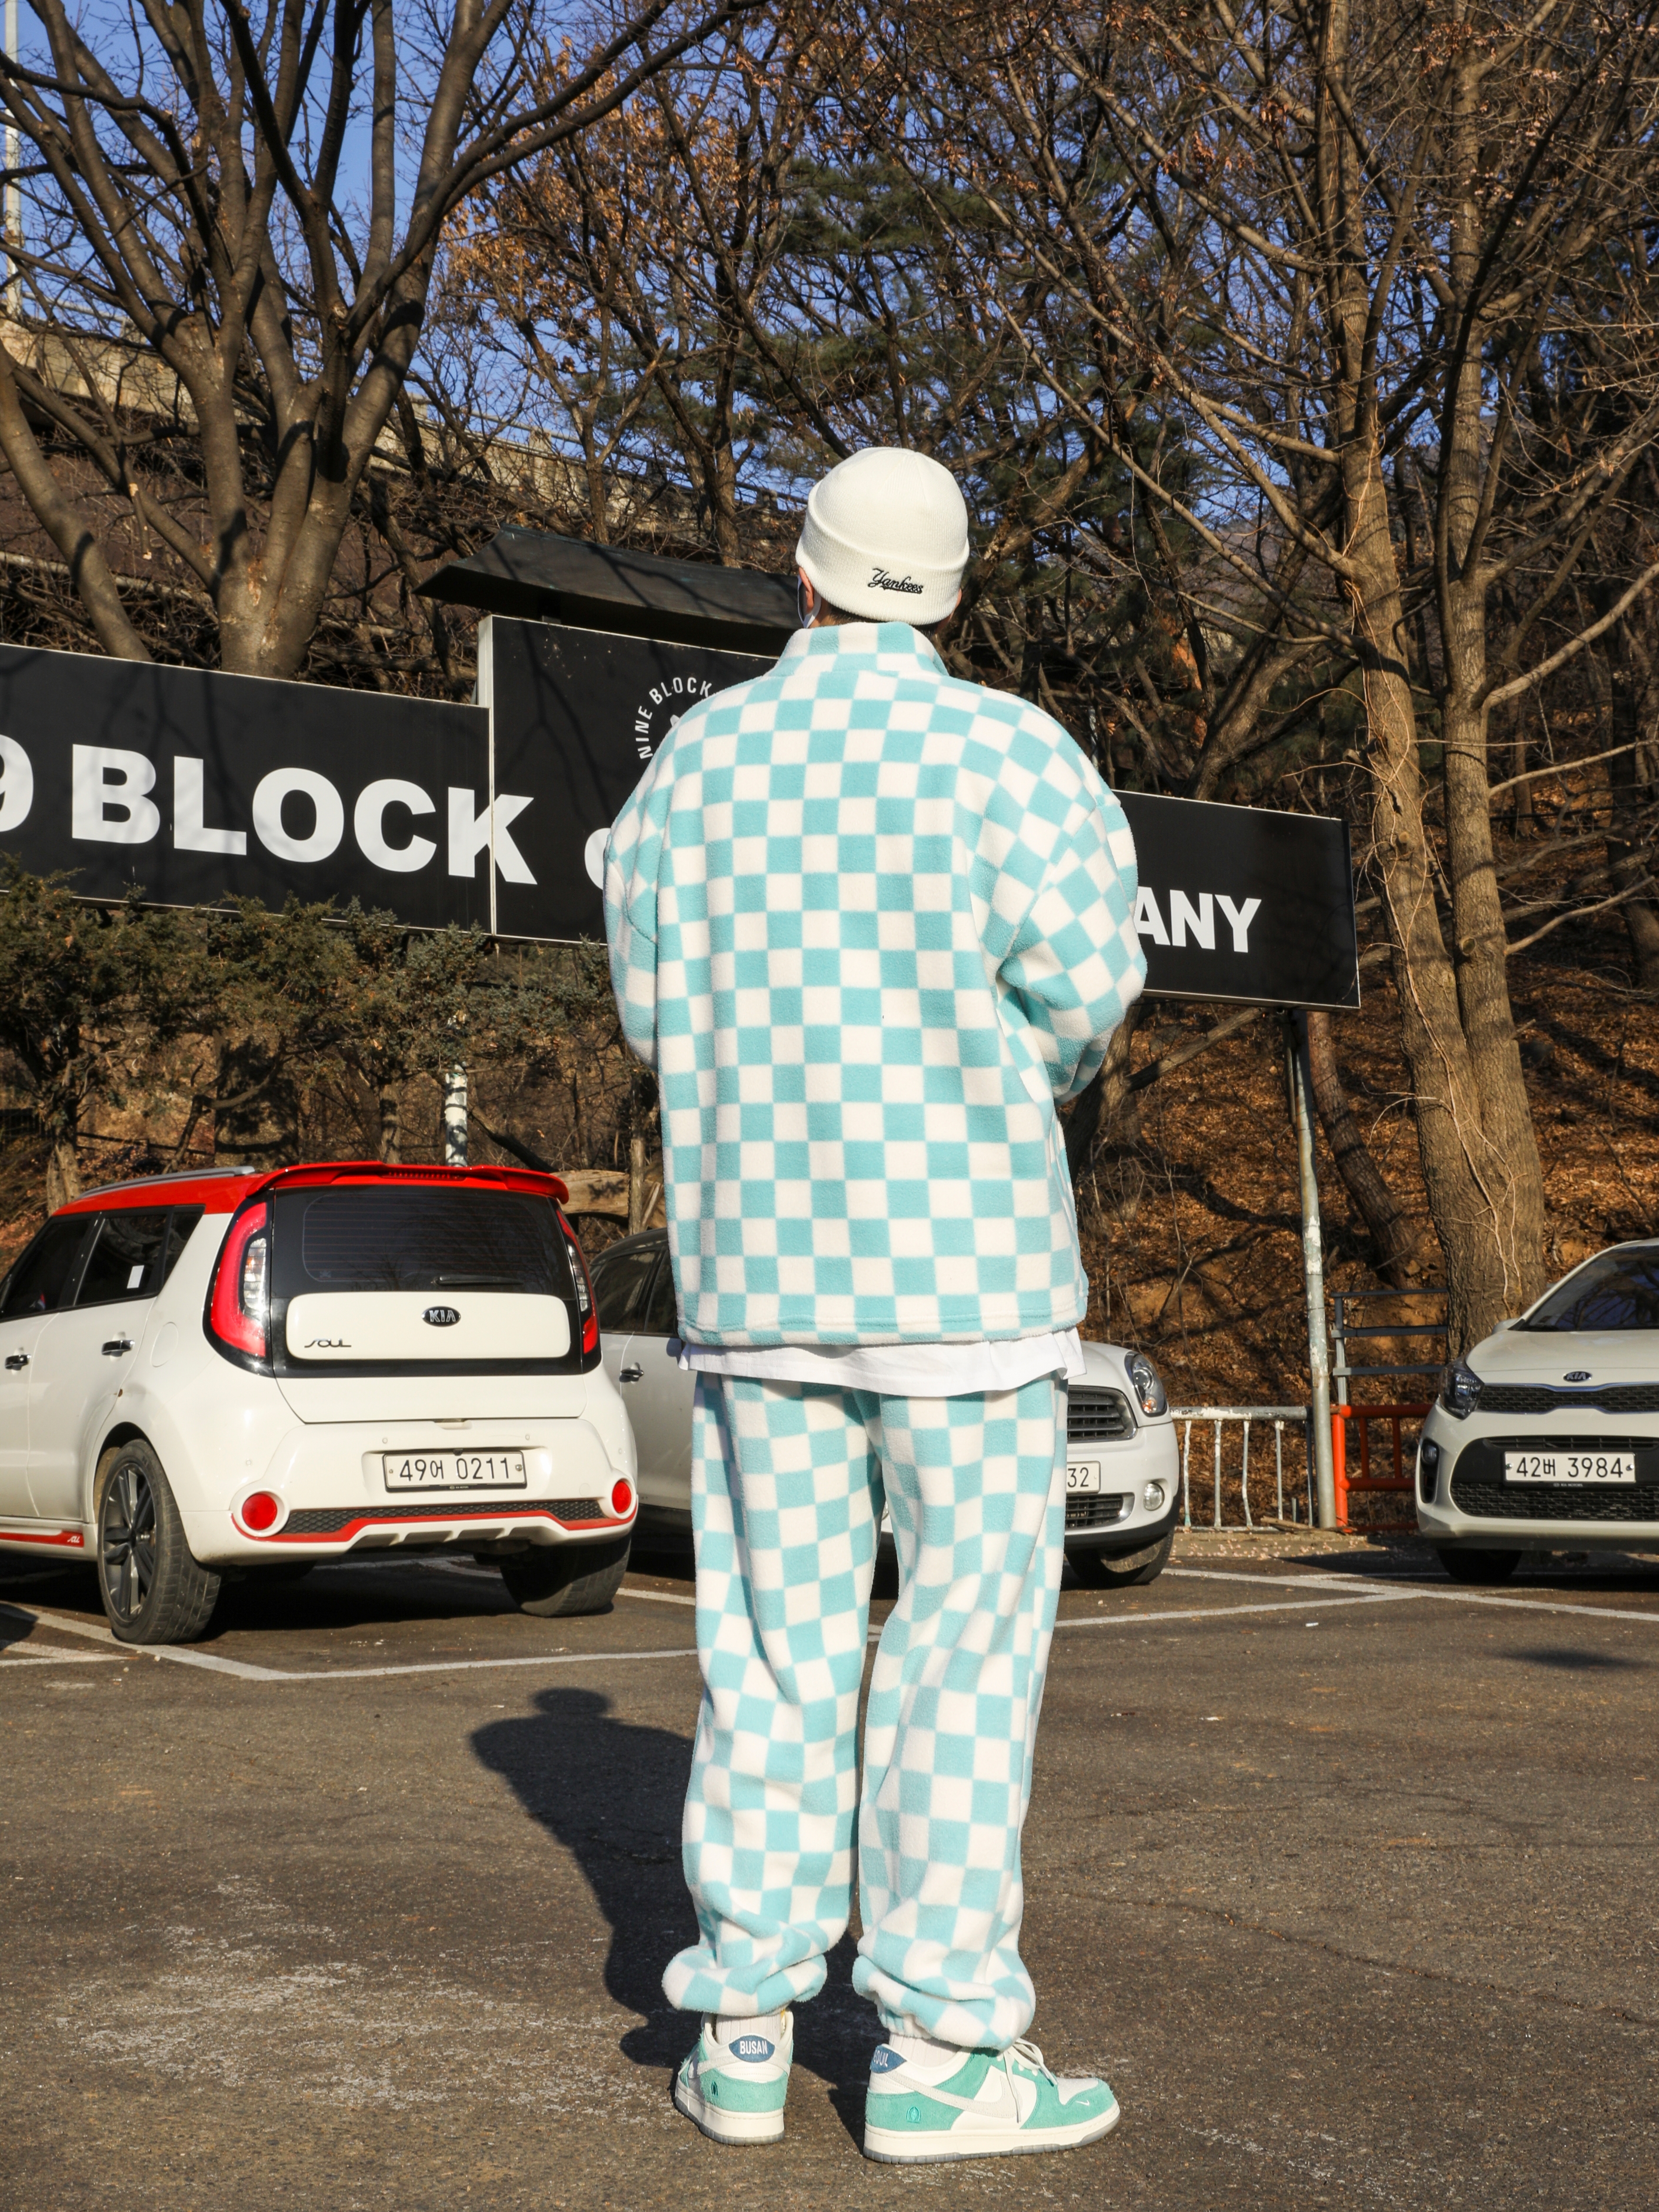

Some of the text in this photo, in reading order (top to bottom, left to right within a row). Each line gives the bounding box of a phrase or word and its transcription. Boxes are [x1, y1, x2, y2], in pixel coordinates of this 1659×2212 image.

[868, 568, 924, 594] Yankees
[635, 677, 712, 759] NINE BLOCK
[72, 743, 537, 885] BLOCK
[304, 1338, 352, 1348] SOUL
[399, 1457, 509, 1481] 49어 0211
[1517, 1457, 1624, 1478] 42버 3984
[739, 2040, 768, 2055] BUSAN
